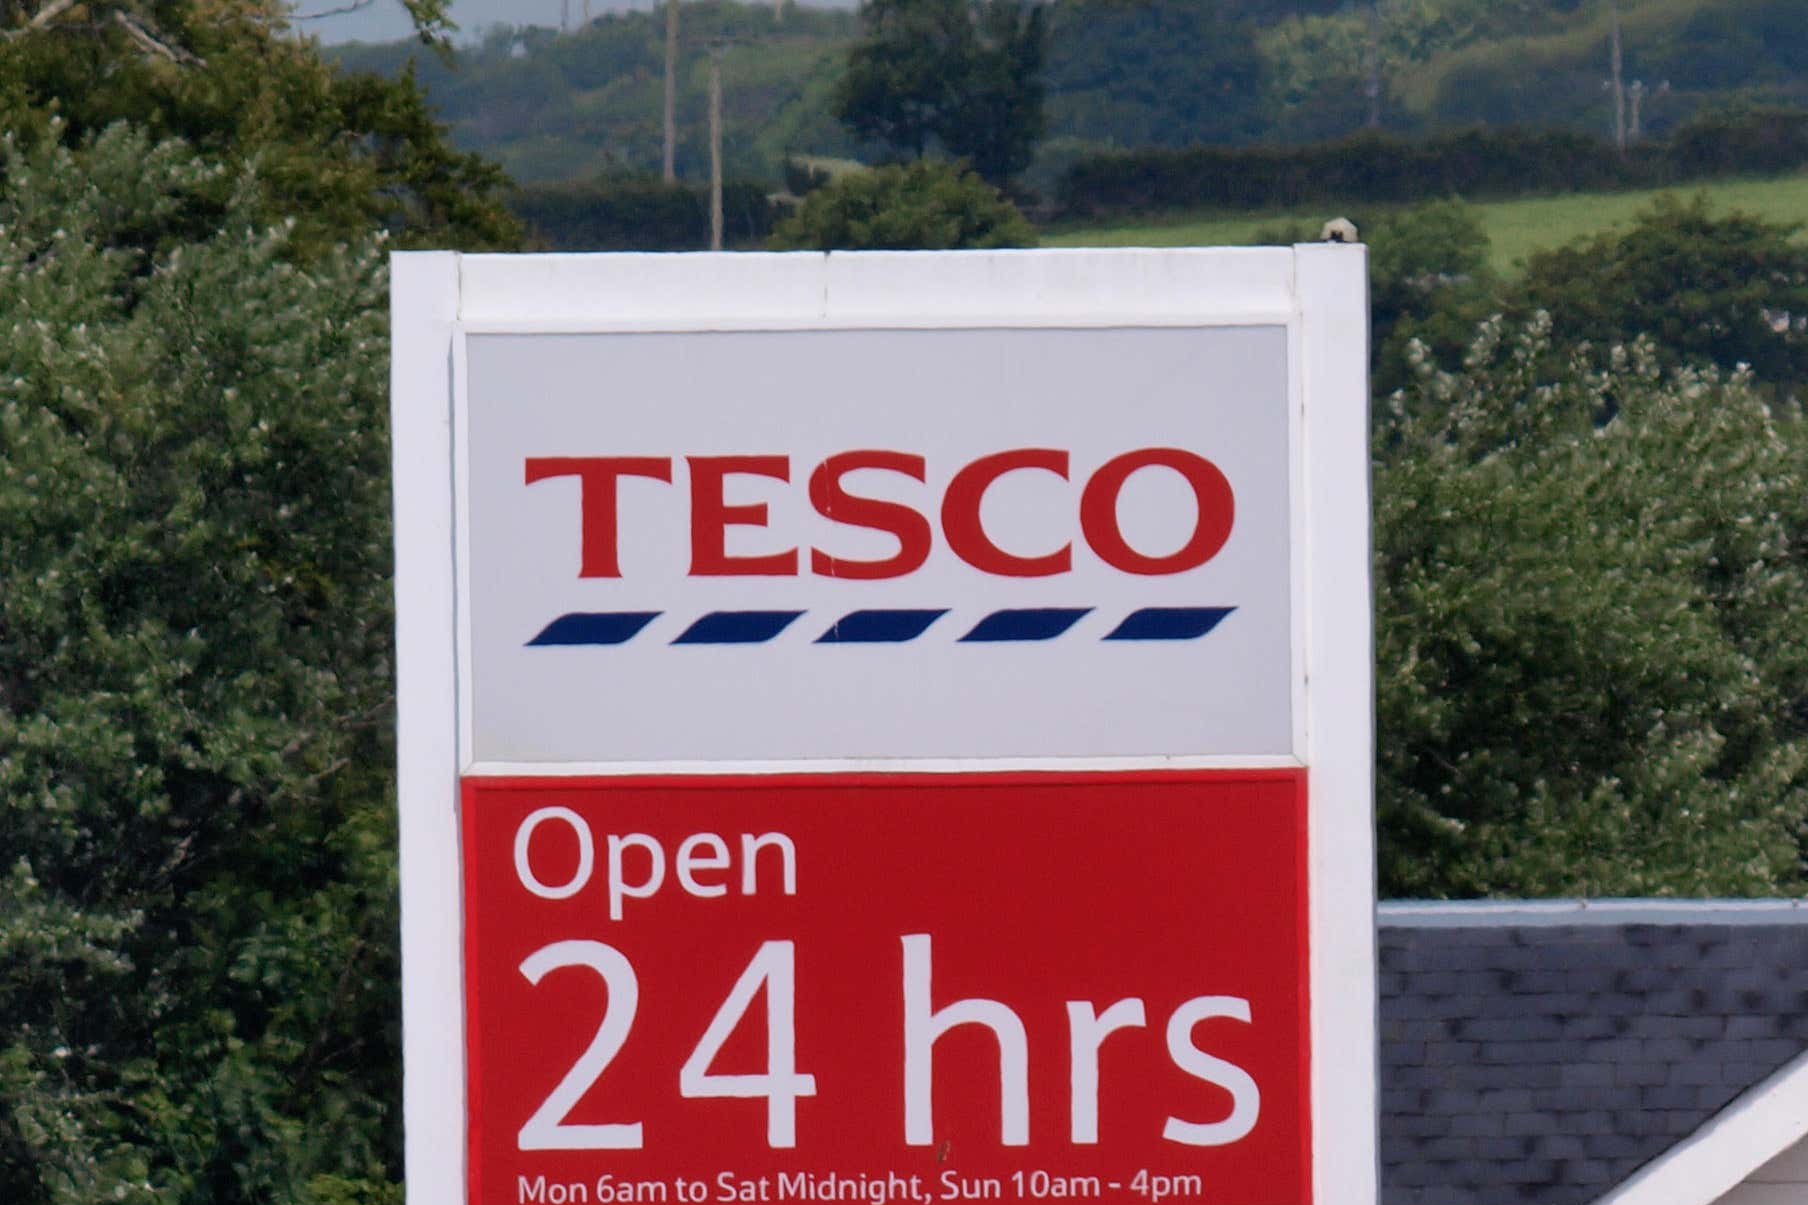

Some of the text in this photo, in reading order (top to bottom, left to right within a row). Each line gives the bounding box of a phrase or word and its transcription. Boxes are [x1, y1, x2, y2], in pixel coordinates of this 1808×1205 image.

[524, 447, 1235, 581] TESCO
[514, 806, 796, 921] Open
[518, 934, 1260, 1151] 24 hrs
[517, 1175, 587, 1204] Mon
[596, 1174, 667, 1203] 6am
[676, 1178, 708, 1202] to
[716, 1172, 770, 1202] Sat
[777, 1172, 931, 1205] Midnight,
[940, 1170, 1000, 1200] Sun
[1012, 1169, 1101, 1199] 10am
[1131, 1169, 1201, 1202] 4pm
